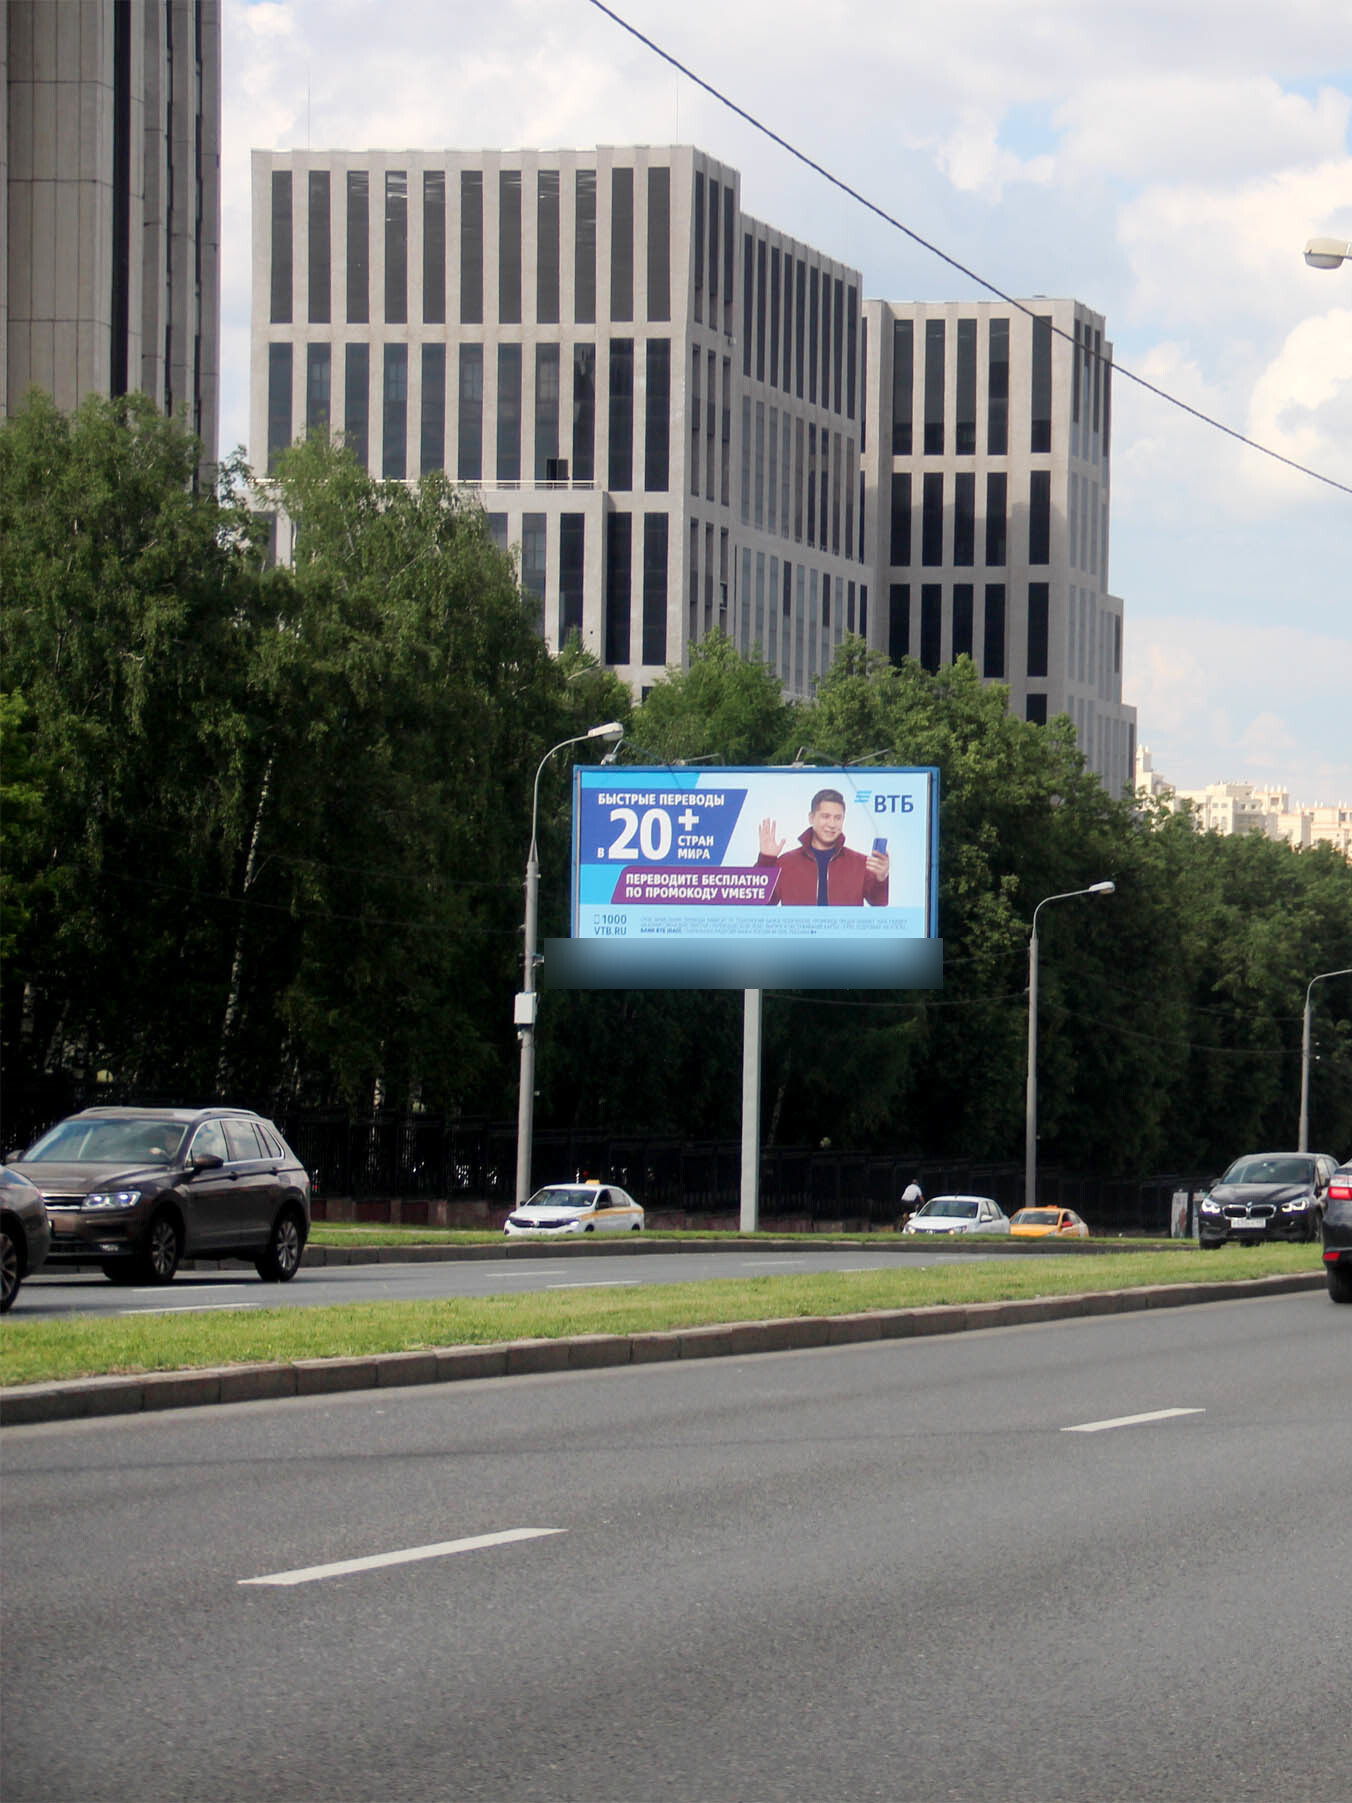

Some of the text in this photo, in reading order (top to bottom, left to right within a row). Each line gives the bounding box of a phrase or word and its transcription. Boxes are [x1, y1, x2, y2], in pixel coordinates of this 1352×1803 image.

[598, 793, 725, 807] БЫСТРЫЕ ПЕРЕВОДЫ
[874, 794, 914, 813] ВТБ
[678, 836, 714, 846] СТРАН
[678, 848, 711, 859] МИРА
[626, 873, 769, 886] ПЕРЕВОДИТЕ БЕСПЛАТНО
[626, 887, 765, 900] ПО ПРОМОКОДУ VMESTE
[602, 914, 627, 925] 1000
[593, 926, 627, 936] VTB.RU
